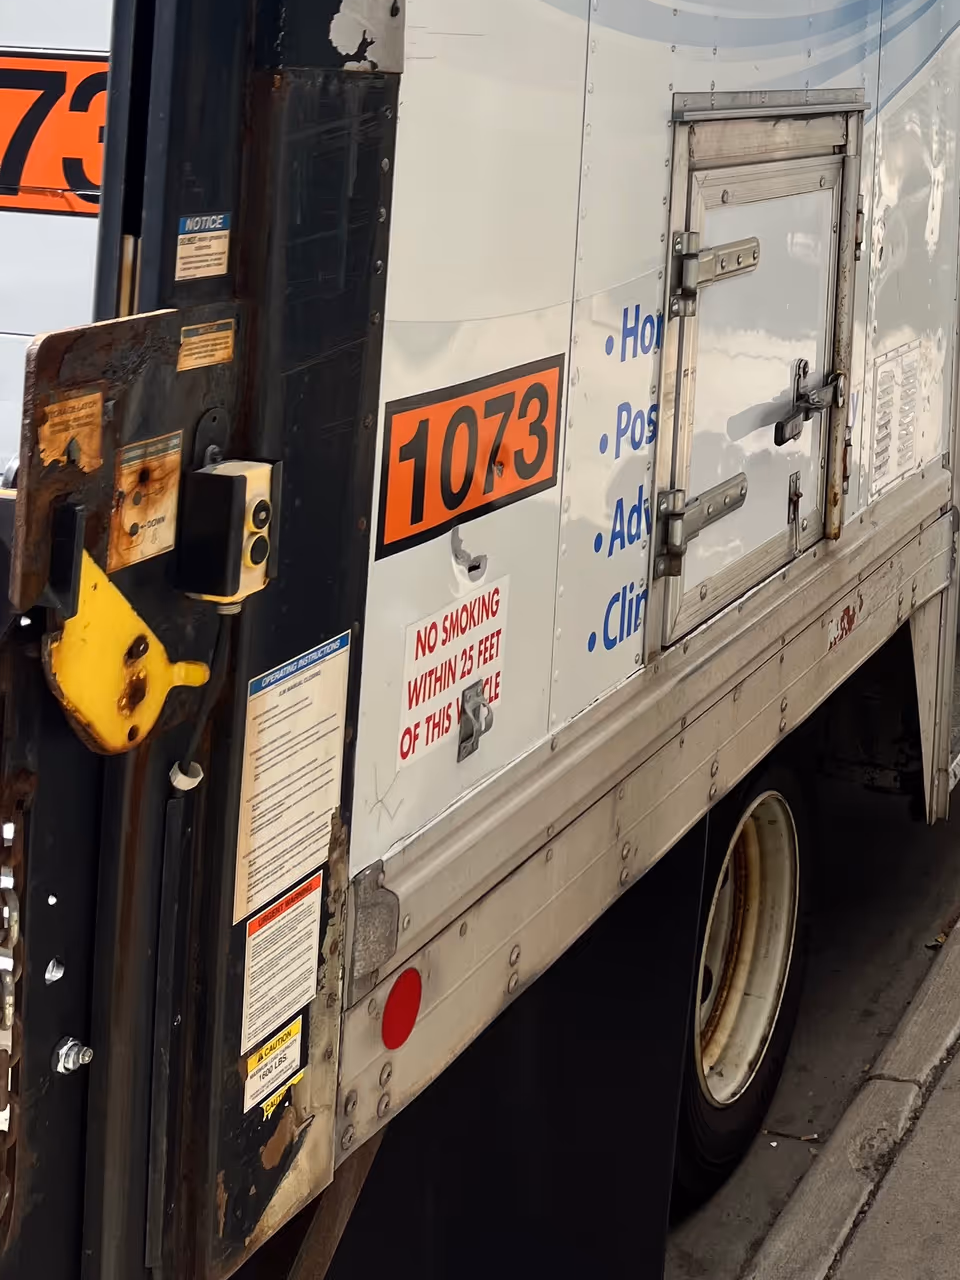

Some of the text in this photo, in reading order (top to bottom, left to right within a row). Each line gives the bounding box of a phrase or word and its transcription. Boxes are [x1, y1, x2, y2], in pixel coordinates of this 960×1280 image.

[185, 214, 225, 231] NOTICE
[398, 381, 550, 527] 1073
[414, 586, 500, 662] NO SMOKING
[261, 639, 341, 687] OPERATING INSTRUCTIONS
[407, 627, 502, 711] WITHIN 25 FEET
[399, 720, 421, 761] OF
[425, 701, 453, 747] THIS
[258, 883, 313, 927] URGENT WARNING
[264, 1029, 293, 1057] CAUTION
